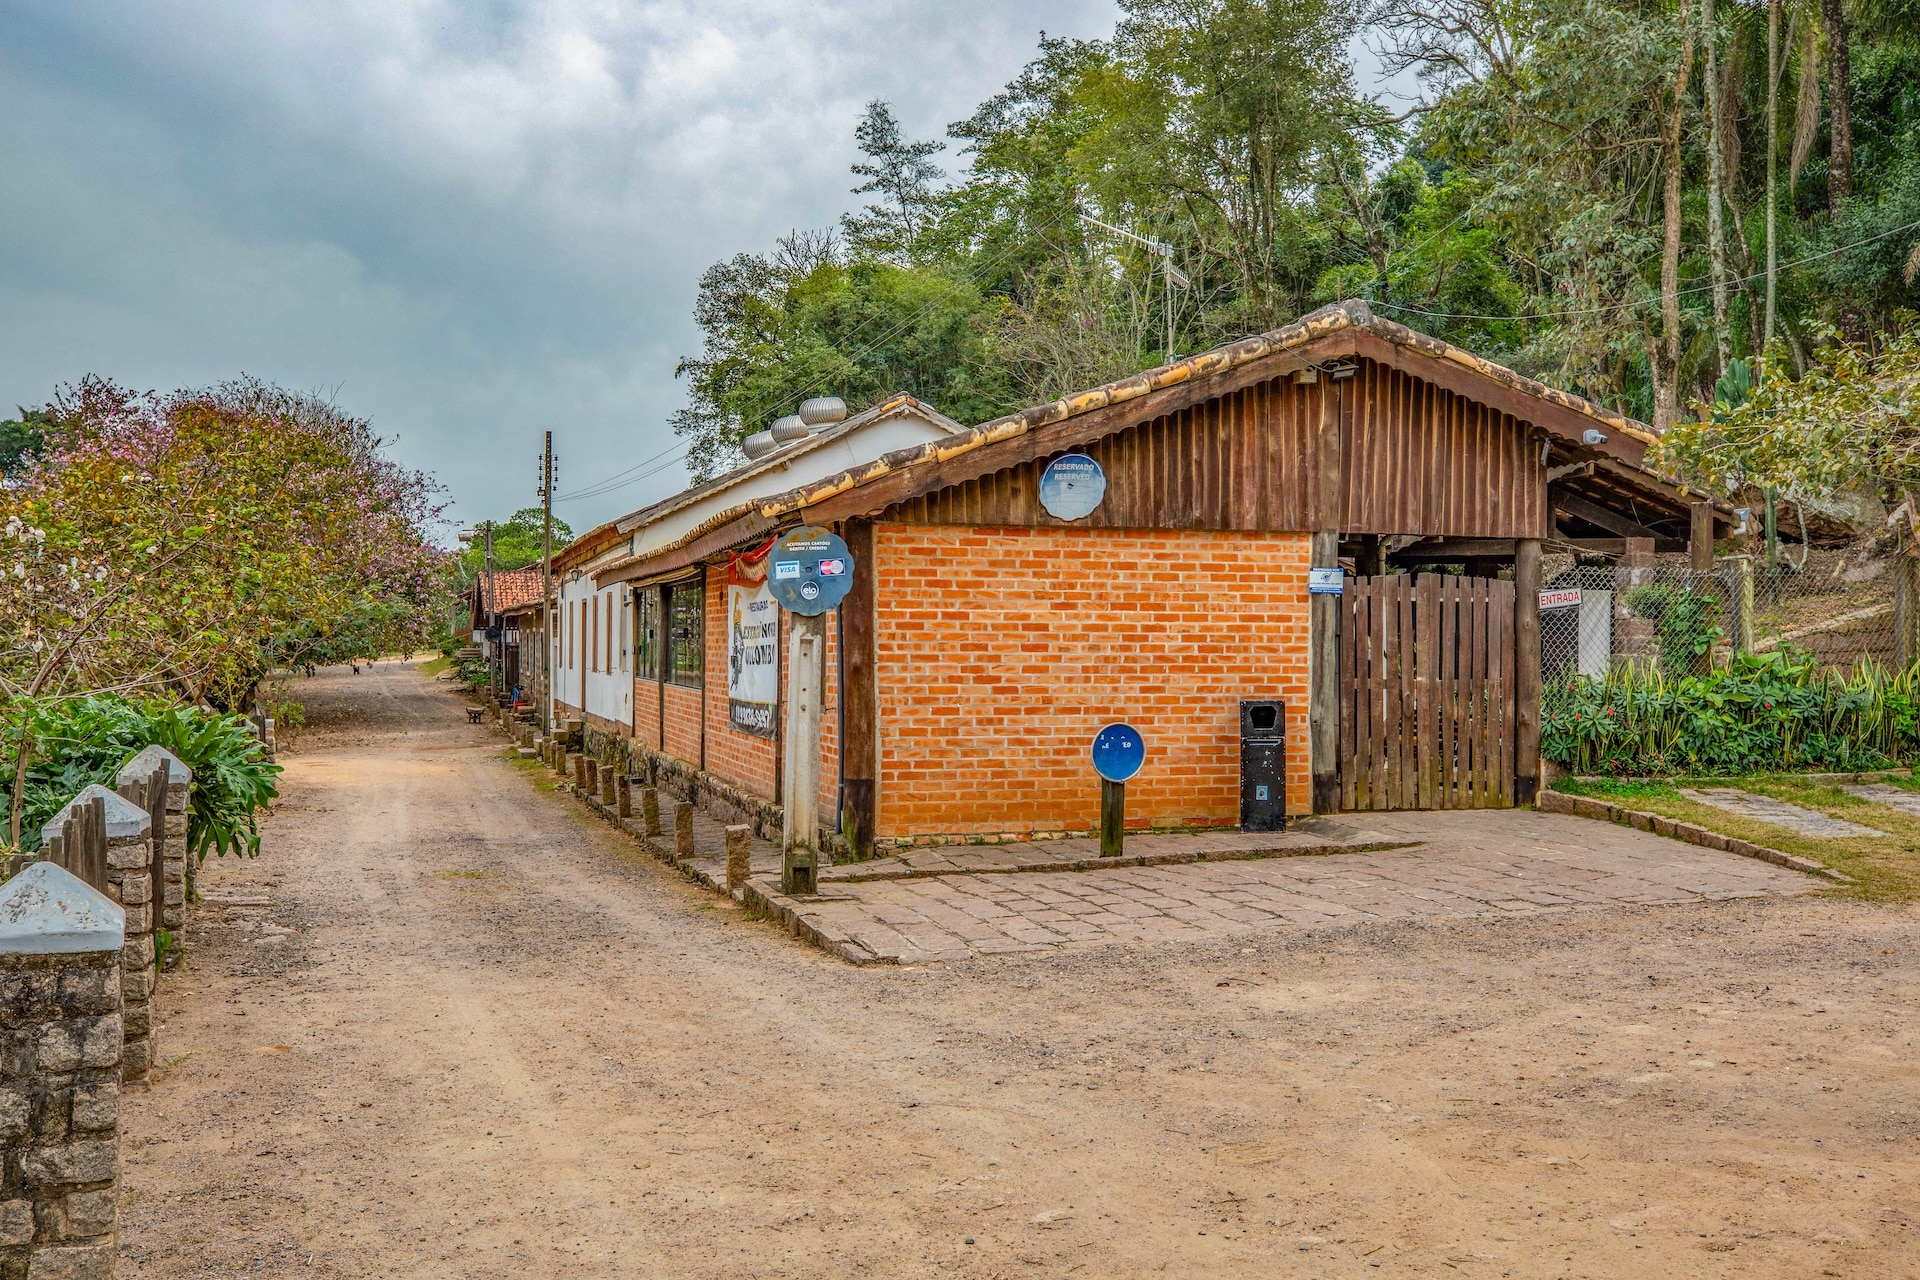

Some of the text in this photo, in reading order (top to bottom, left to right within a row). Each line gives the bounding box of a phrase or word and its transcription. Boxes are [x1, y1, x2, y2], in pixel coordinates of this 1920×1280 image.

[1053, 463, 1094, 471] RESERVADO
[1054, 473, 1090, 481] RESERVED
[1541, 592, 1580, 605] ENTRADA
